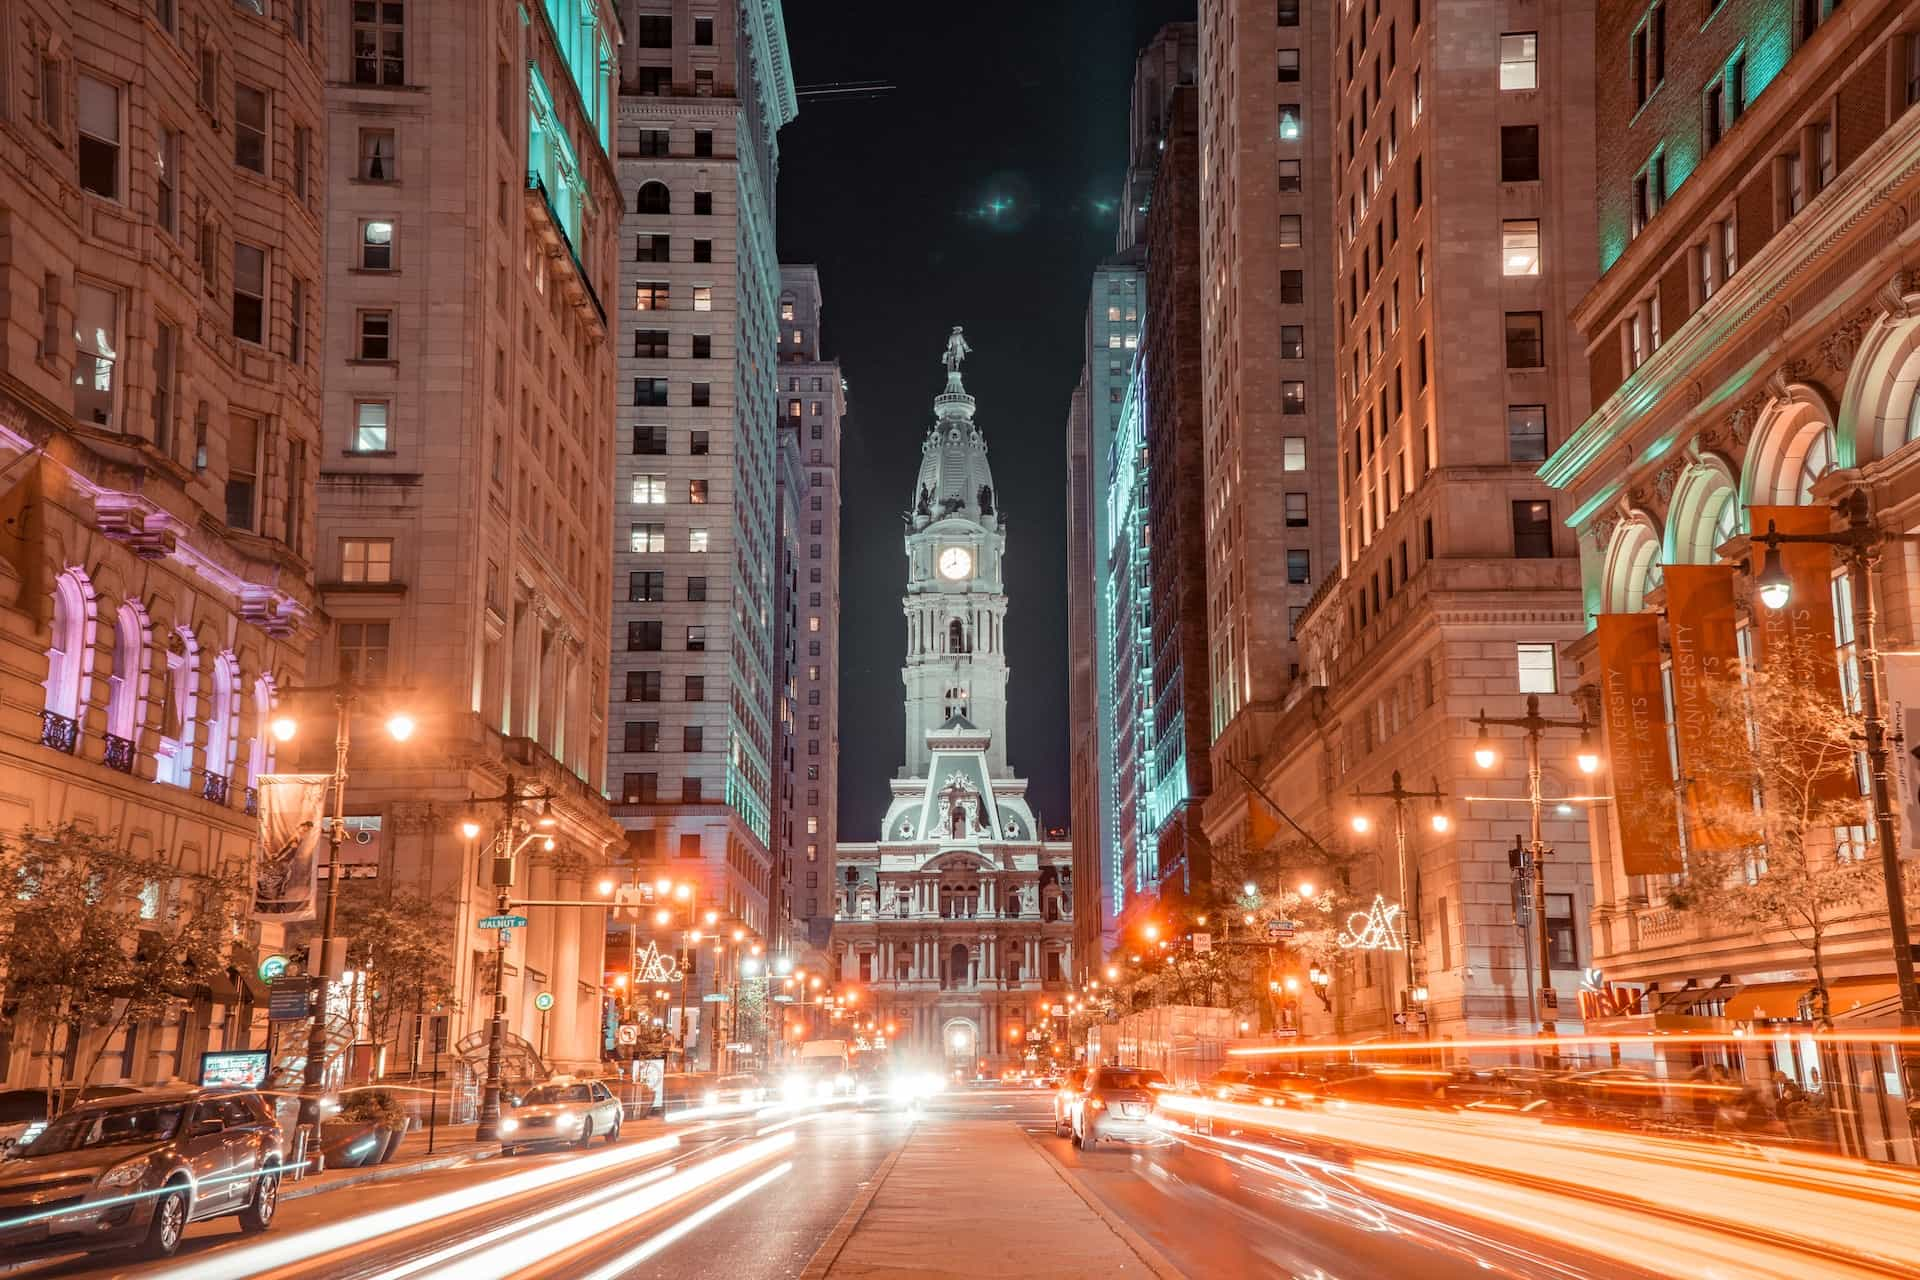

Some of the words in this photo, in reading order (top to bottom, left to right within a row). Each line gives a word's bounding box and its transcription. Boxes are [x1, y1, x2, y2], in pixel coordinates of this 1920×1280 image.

[1631, 696, 1650, 742] ARTS
[1676, 623, 1703, 738] UNIVERSITY
[1607, 667, 1634, 775] UNIVERSITY
[480, 919, 514, 928] WALNUT
